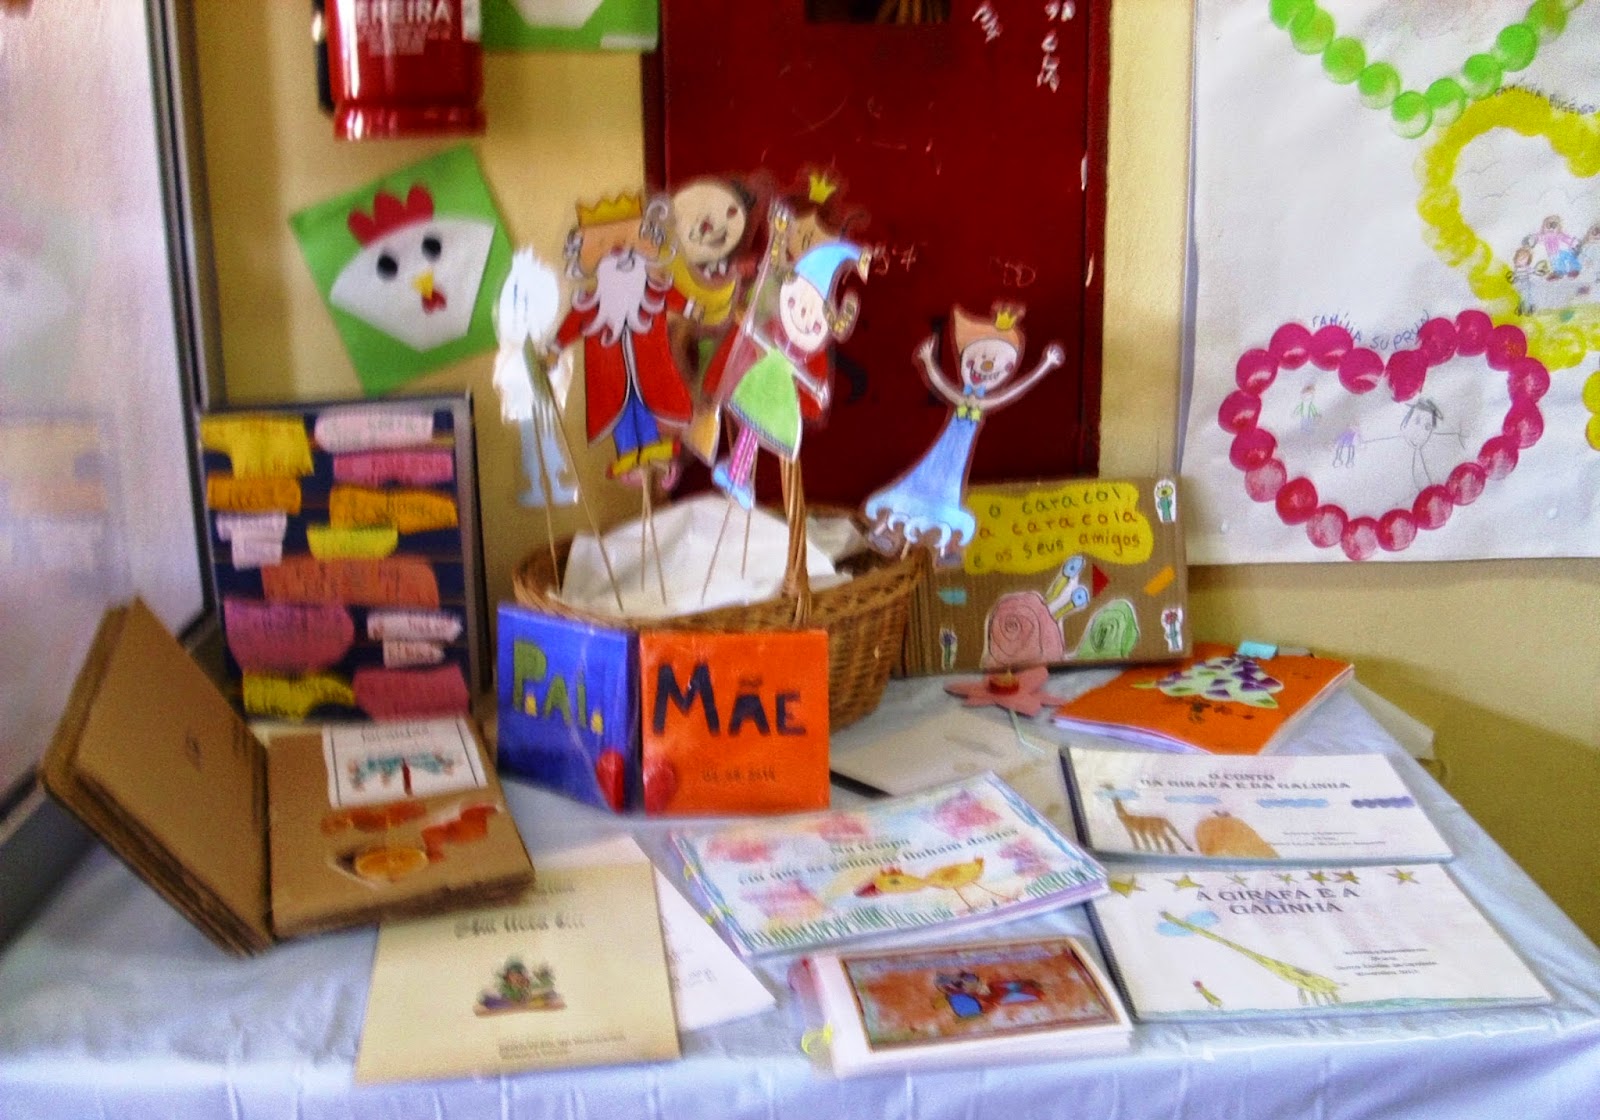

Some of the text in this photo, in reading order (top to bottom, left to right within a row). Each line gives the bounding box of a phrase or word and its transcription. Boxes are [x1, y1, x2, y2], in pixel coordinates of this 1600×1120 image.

[1021, 487, 1122, 515] caracol
[978, 507, 1138, 540] a caracola
[973, 553, 985, 569] e
[995, 549, 1013, 564] os
[1078, 530, 1141, 558] amigos
[1197, 886, 1361, 901] A GIRAFA E A
[1229, 901, 1344, 915] GALINHA
